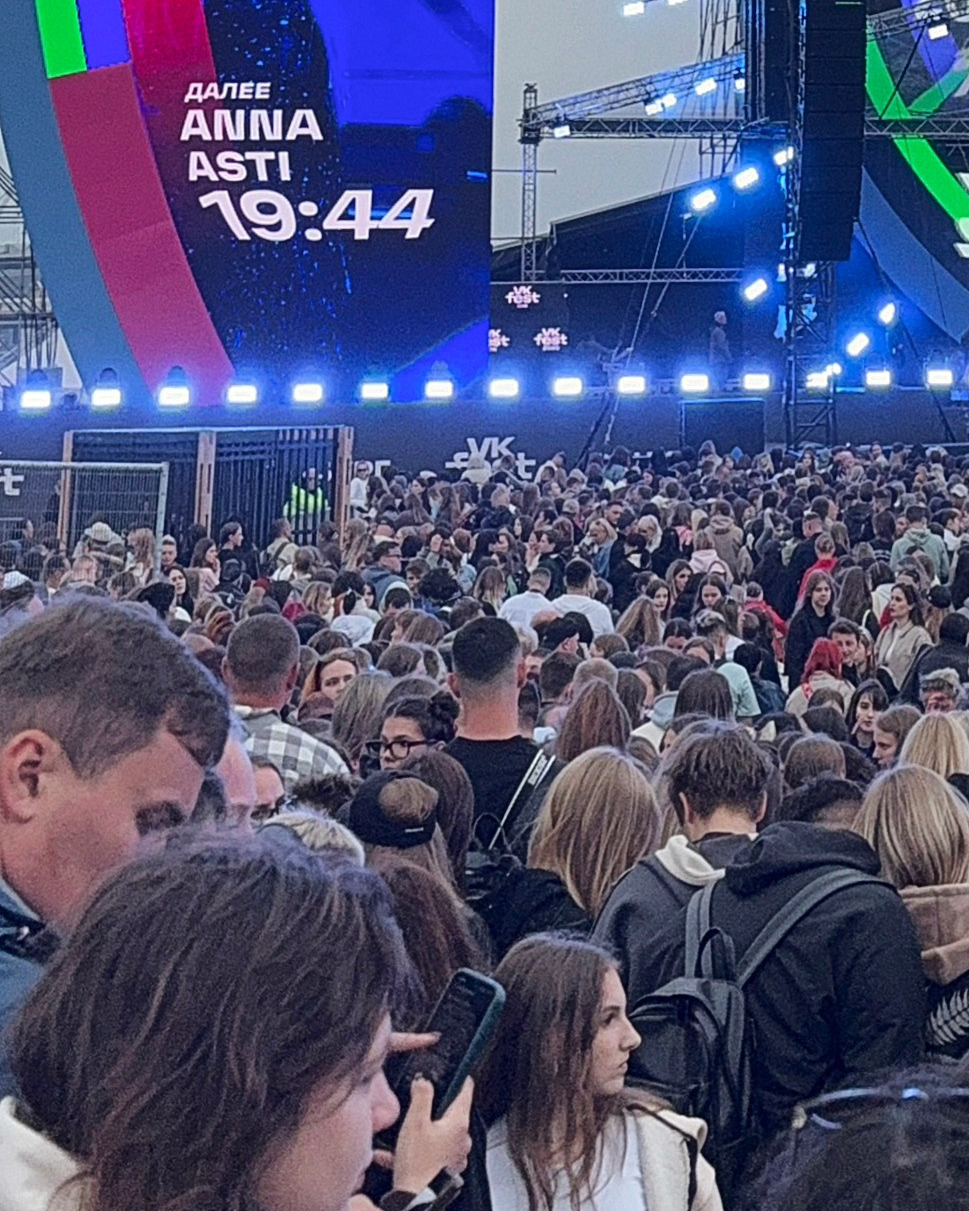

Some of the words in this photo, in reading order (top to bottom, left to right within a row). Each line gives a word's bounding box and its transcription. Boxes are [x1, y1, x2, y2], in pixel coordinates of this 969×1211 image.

[184, 82, 271, 103] ДАЛЕЕ
[180, 109, 324, 141] ANNA
[188, 150, 291, 181] ASTI
[198, 188, 435, 242] 19:44
[466, 436, 516, 459] VK
